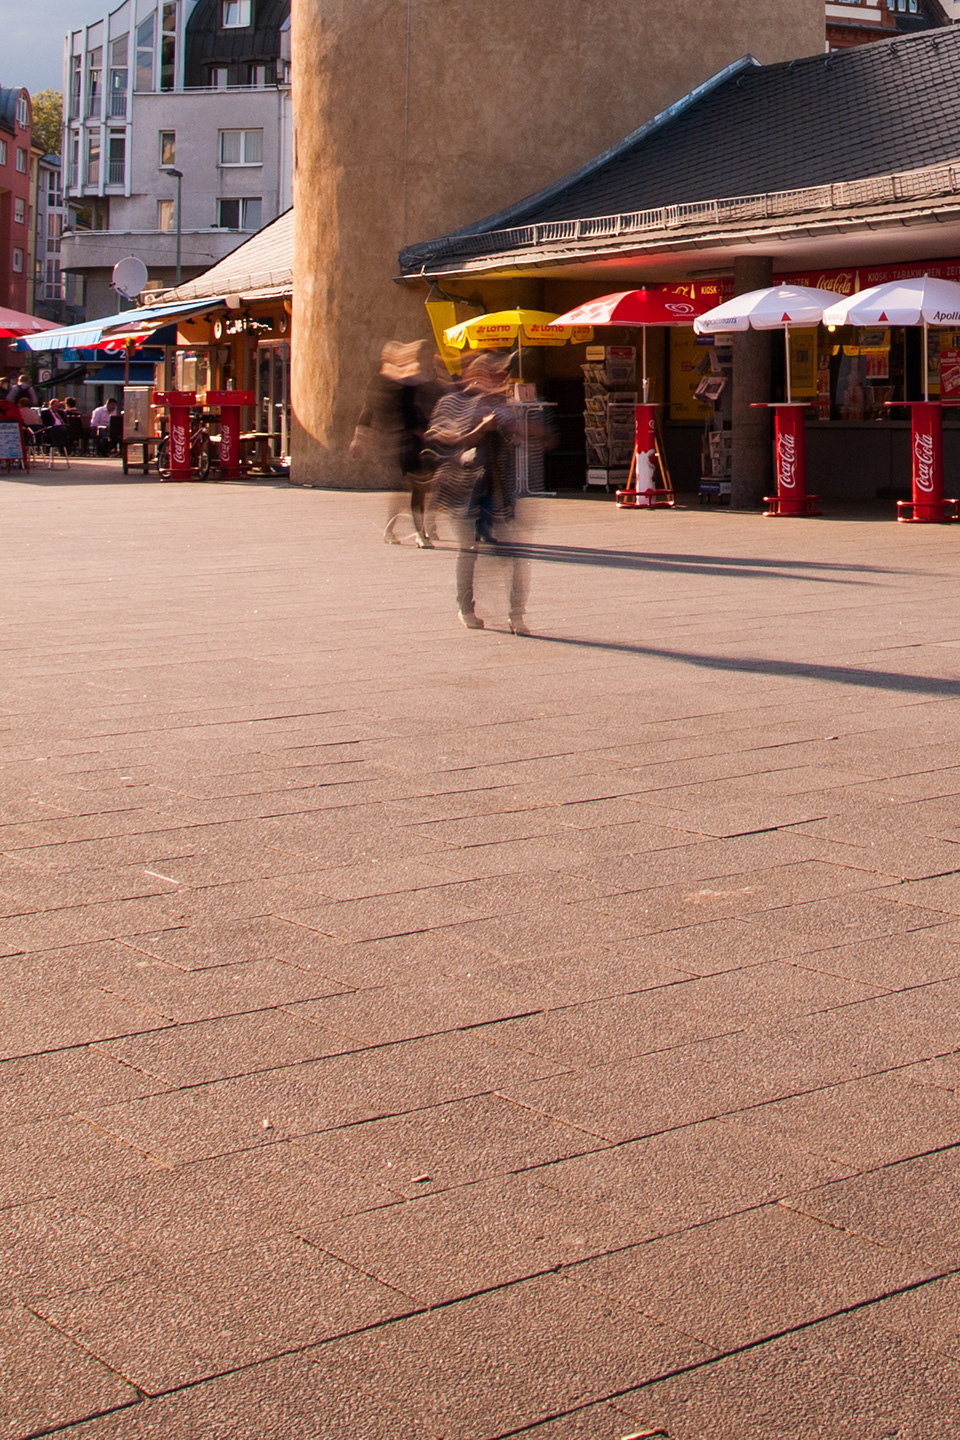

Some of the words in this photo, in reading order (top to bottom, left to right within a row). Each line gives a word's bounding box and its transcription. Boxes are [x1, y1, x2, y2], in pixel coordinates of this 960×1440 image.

[486, 325, 511, 333] LOTTO
[541, 324, 564, 333] LOTTO
[172, 423, 186, 463] Coca-Cola
[220, 424, 231, 462] Coca-Cola
[778, 431, 796, 488] Coca-Cola
[915, 431, 933, 492] Coca-Cola
